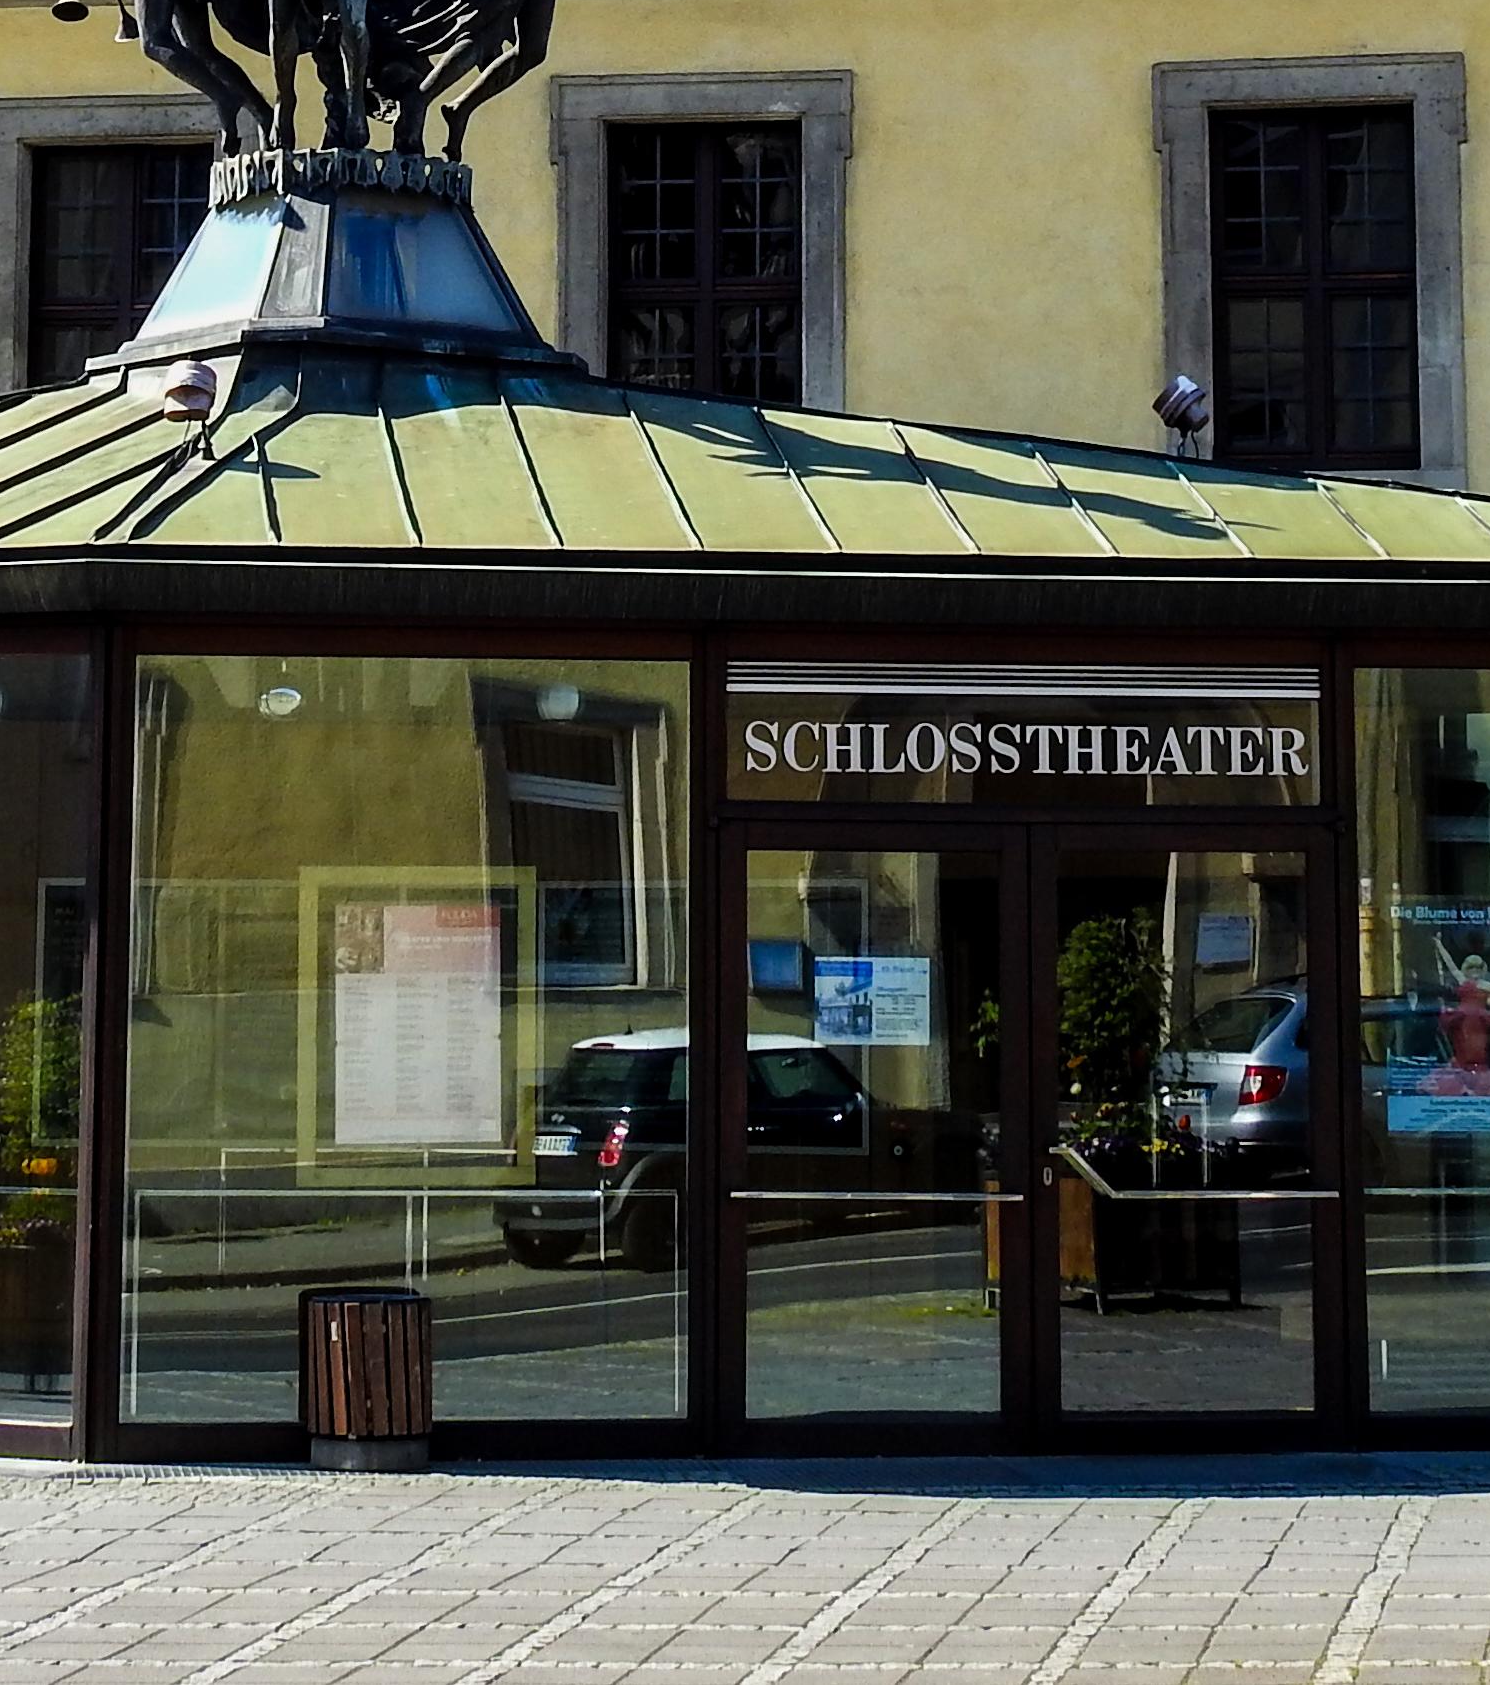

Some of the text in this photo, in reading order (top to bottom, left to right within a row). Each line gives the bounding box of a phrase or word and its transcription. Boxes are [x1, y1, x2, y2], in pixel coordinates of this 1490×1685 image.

[744, 719, 1310, 777] SCHLOSSTHEATER
[1391, 906, 1413, 919] Die
[1415, 906, 1458, 919] Blume
[1460, 909, 1485, 919] von
